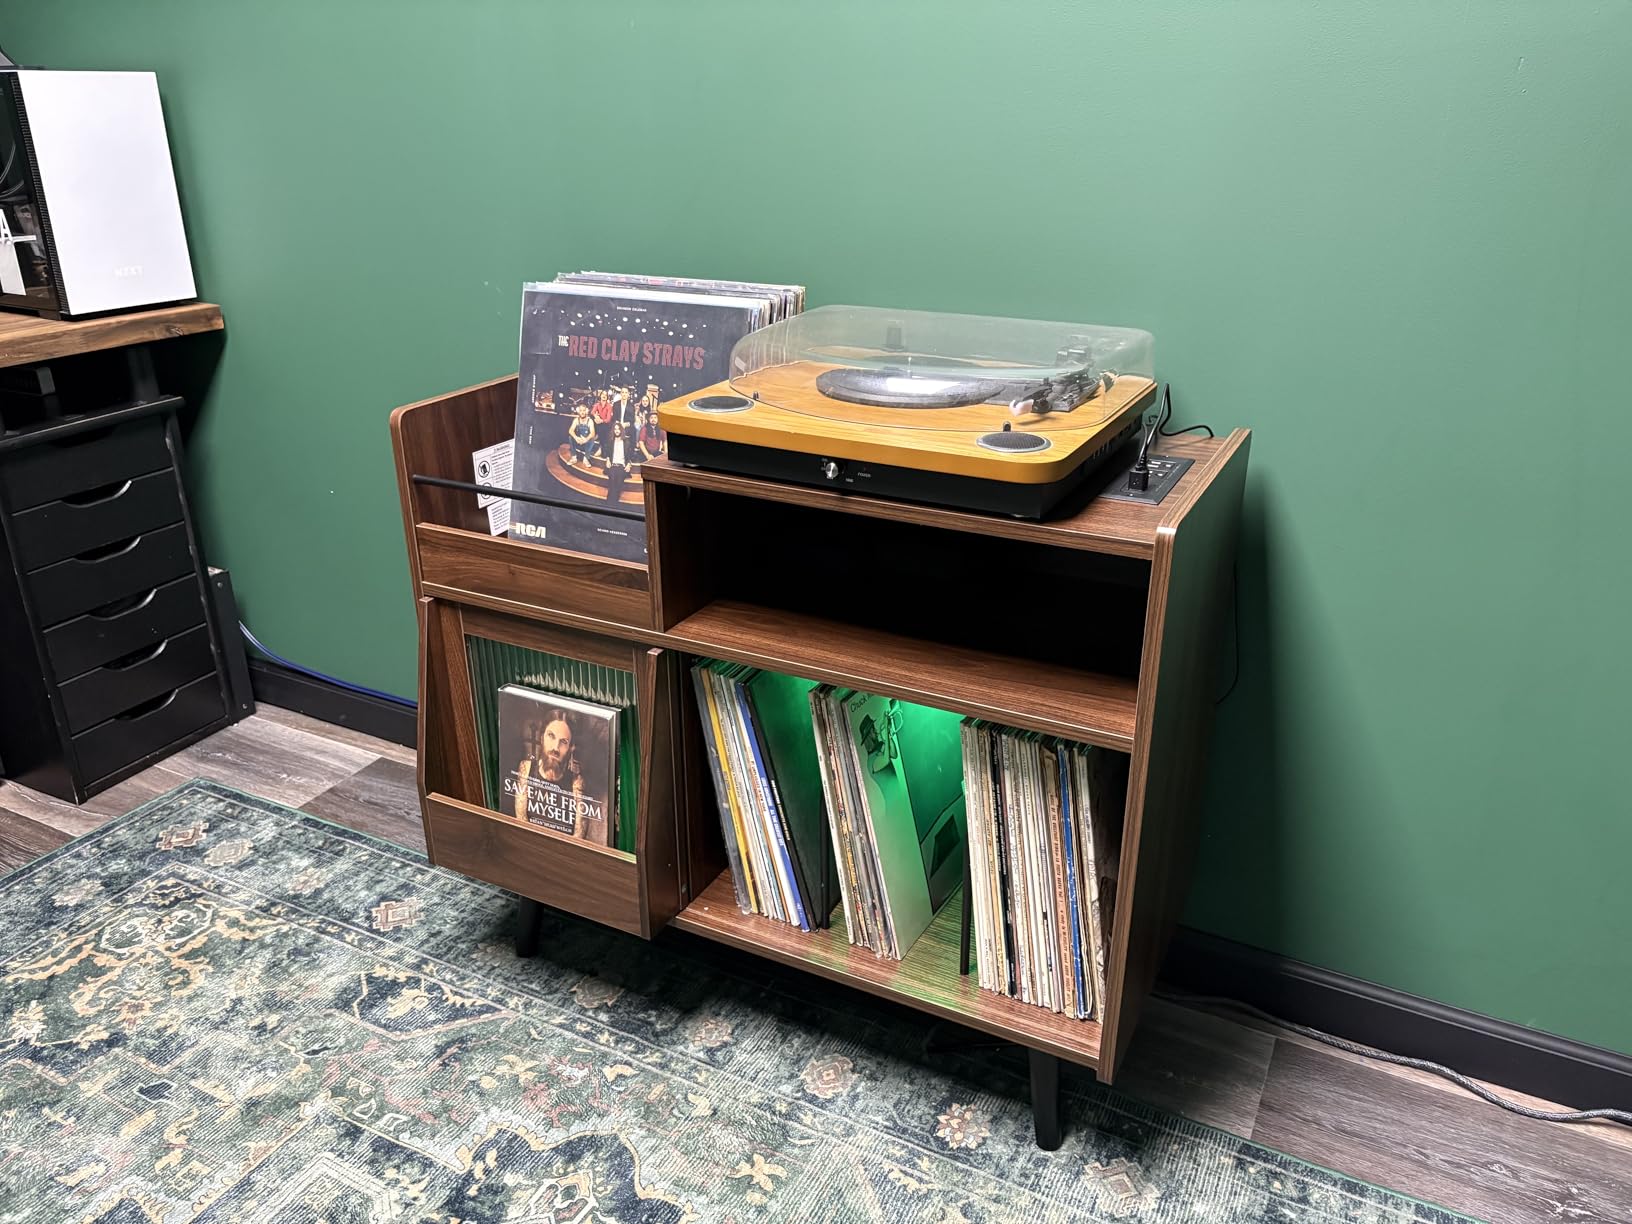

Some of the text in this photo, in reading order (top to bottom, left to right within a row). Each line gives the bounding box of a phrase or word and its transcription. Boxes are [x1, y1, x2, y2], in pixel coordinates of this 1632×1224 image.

[114, 266, 144, 278] NZXT
[558, 335, 705, 370] THE RED CLAY STRAYS
[515, 522, 546, 538] RCA
[504, 778, 534, 798] SAVE
[537, 790, 557, 806] ME
[561, 795, 601, 820] FROM
[528, 799, 576, 825] MYSELF
